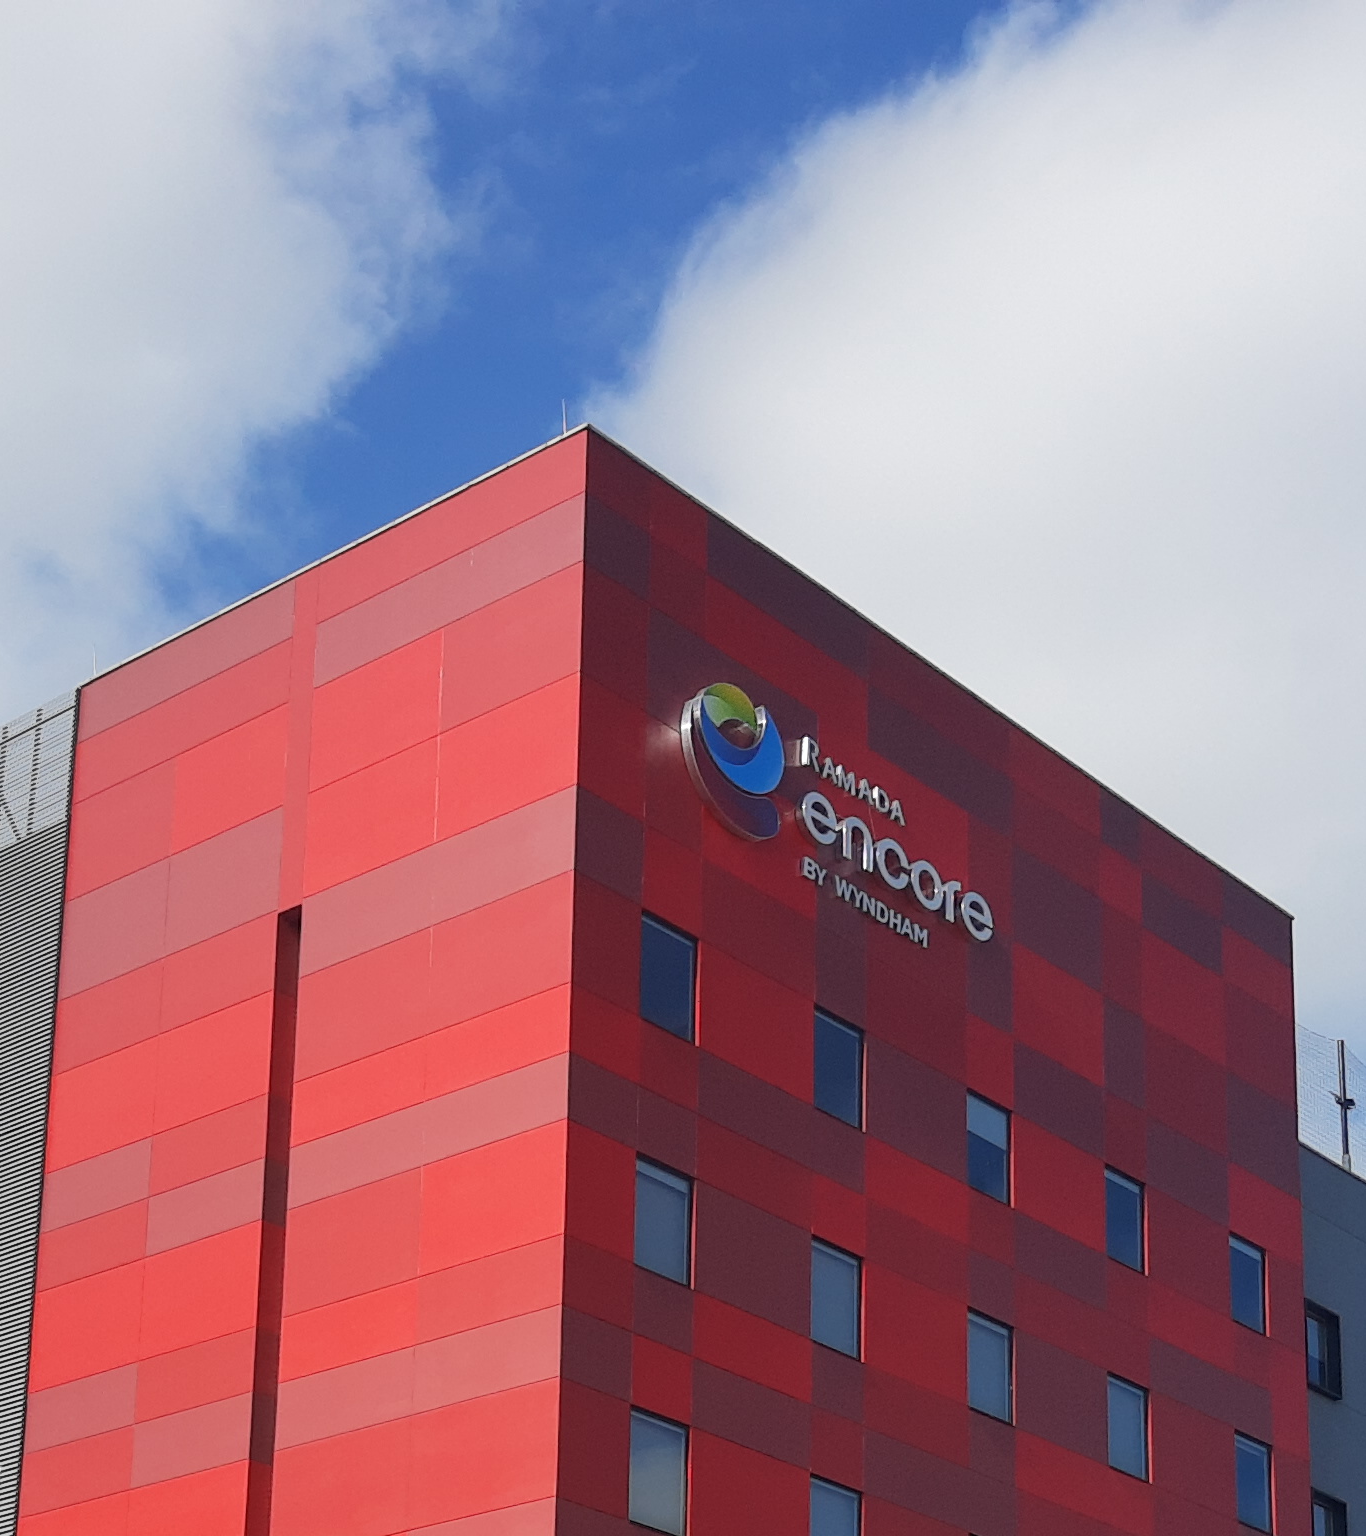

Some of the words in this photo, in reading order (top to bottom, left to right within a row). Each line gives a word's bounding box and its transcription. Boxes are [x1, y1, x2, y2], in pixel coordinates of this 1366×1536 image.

[800, 735, 906, 827] RAMADA
[800, 791, 994, 942] encore
[801, 856, 827, 886] BY
[834, 874, 929, 948] WYNDHAM
